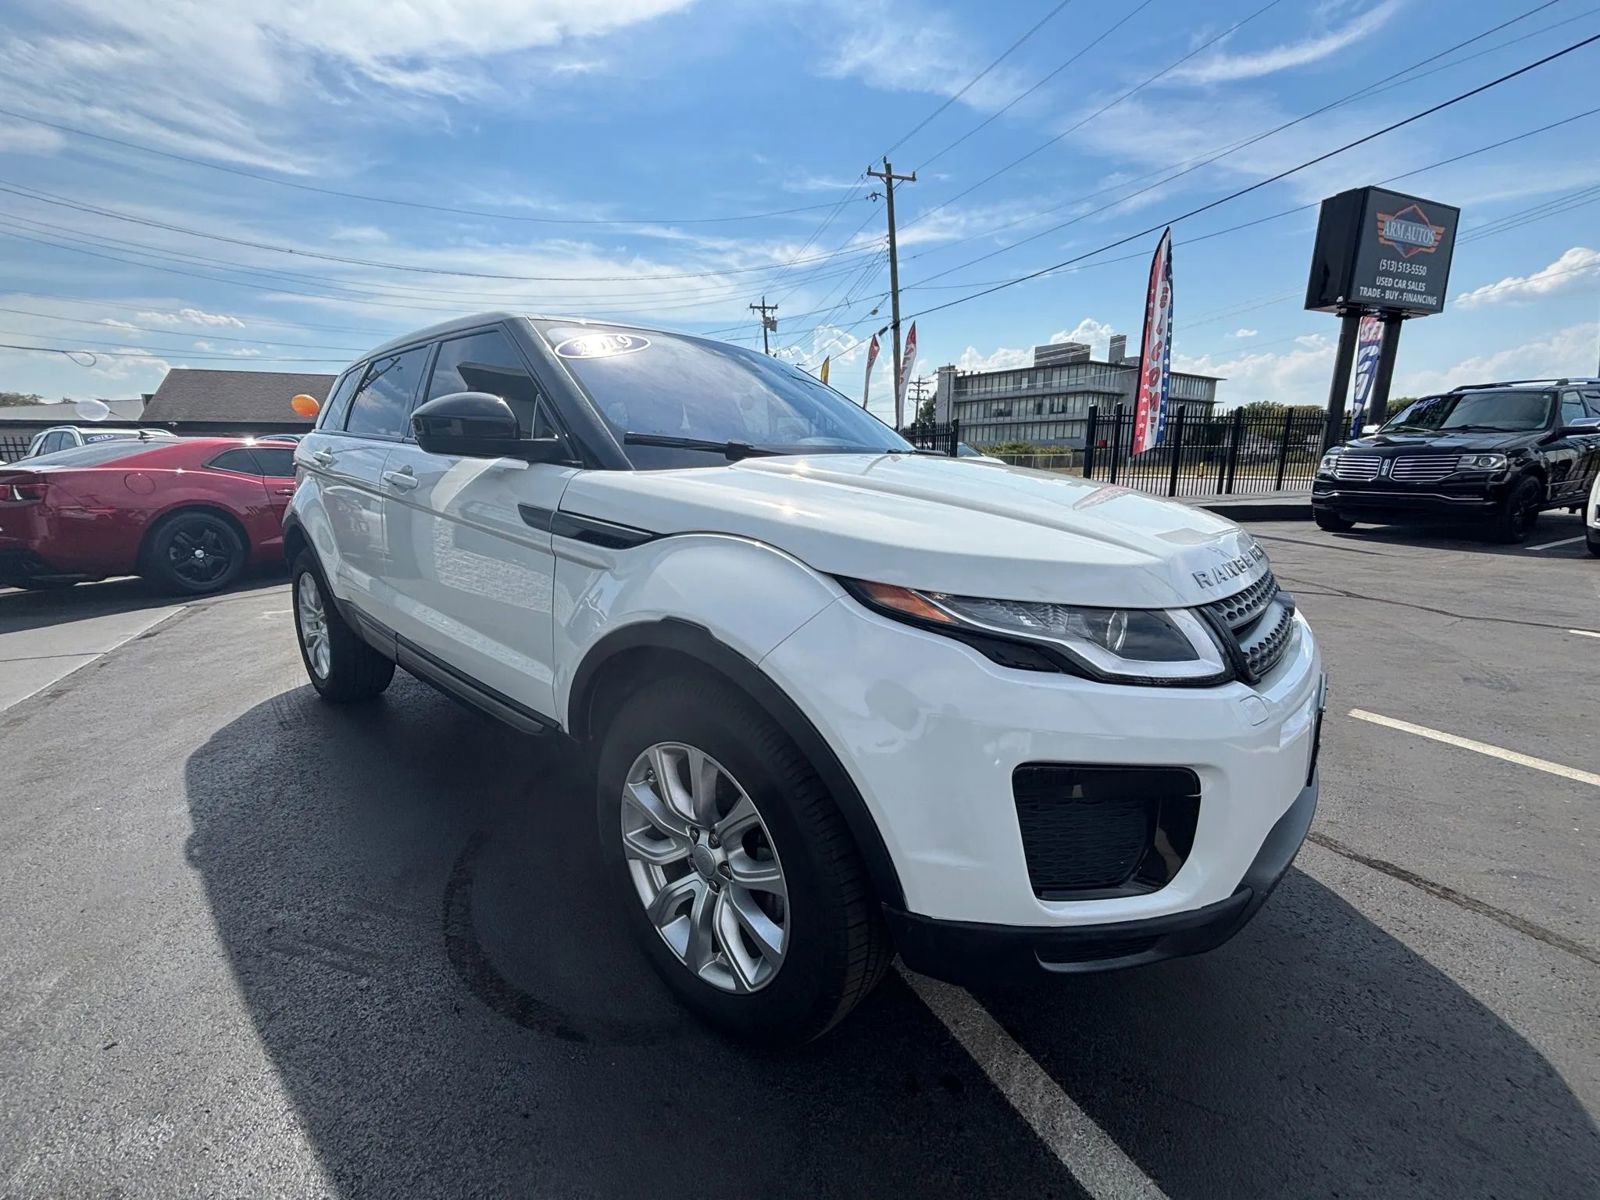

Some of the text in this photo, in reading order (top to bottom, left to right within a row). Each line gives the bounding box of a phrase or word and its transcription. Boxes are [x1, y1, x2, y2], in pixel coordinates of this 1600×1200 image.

[1384, 222, 1435, 244] ARM AUTOS
[1380, 259, 1427, 276] (513) 513-5550
[1376, 276, 1426, 292] USED CAR SALES
[1360, 286, 1381, 298] TRADE
[1385, 289, 1399, 300] BUY
[1402, 292, 1437, 305] FINANCING
[573, 334, 633, 356] 219
[1192, 554, 1253, 589] RANGE
